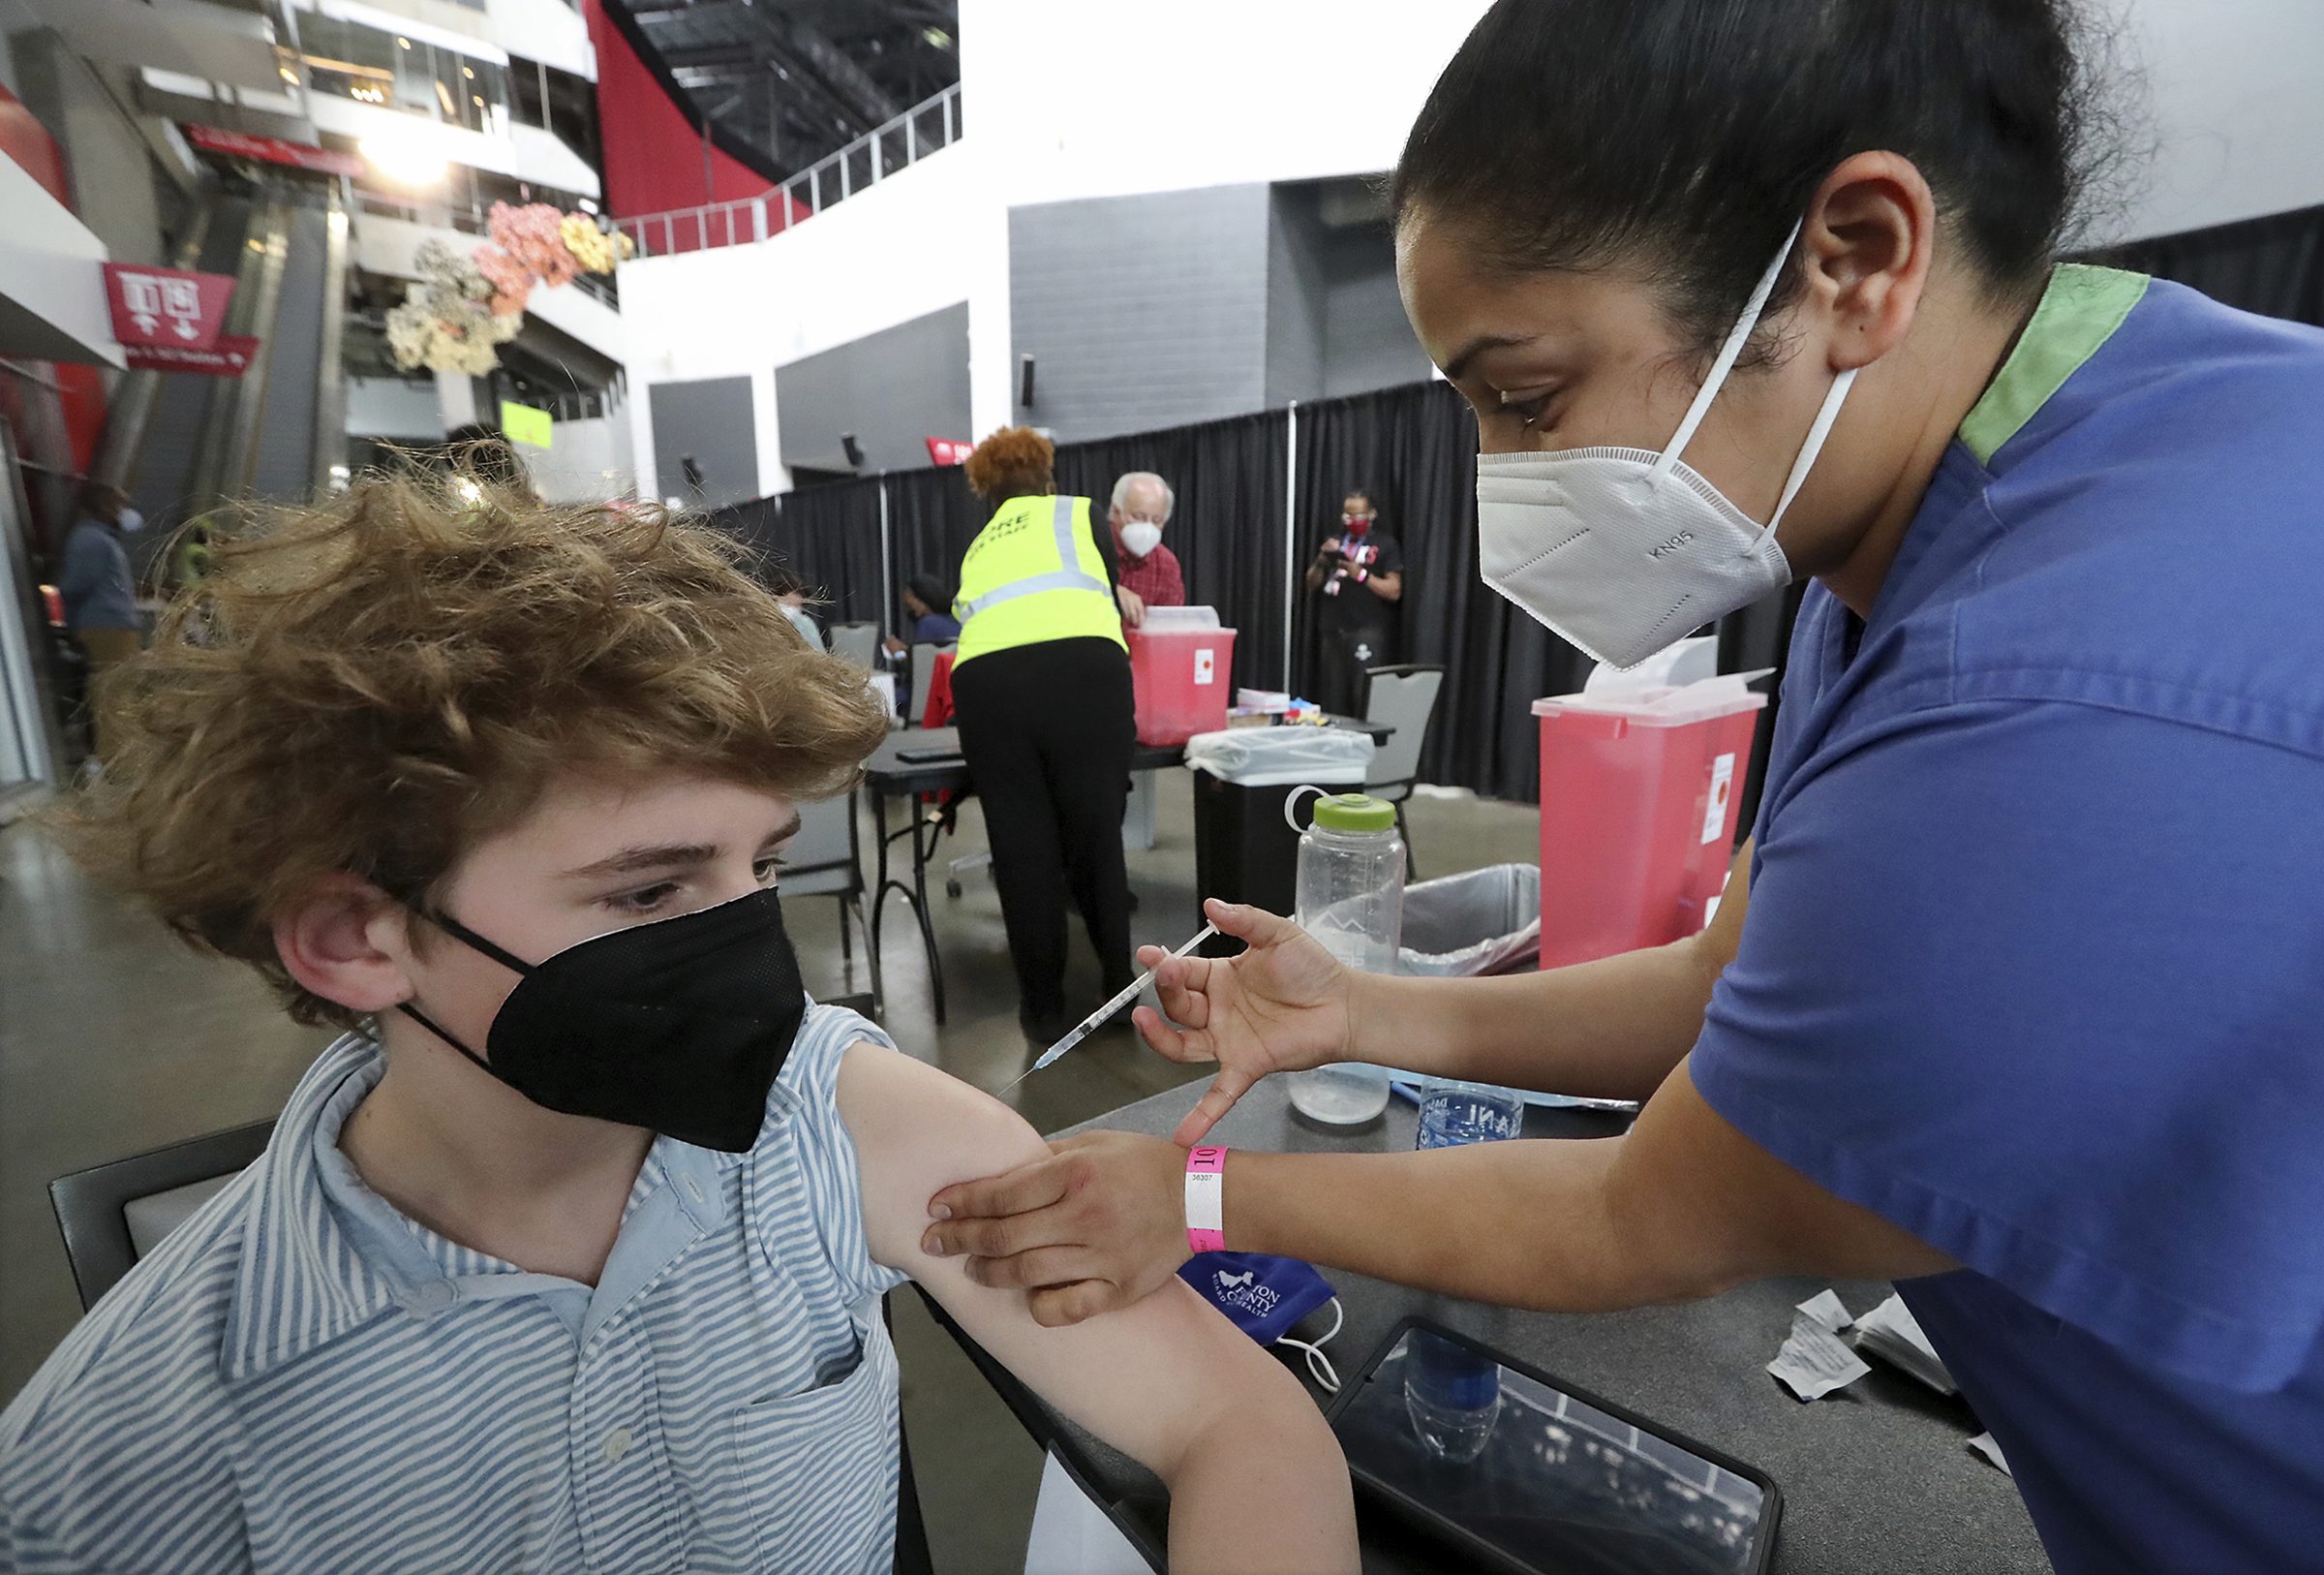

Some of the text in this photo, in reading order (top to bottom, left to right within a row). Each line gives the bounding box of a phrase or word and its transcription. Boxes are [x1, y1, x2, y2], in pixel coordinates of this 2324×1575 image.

[1648, 530, 1694, 560] KN95
[1194, 1149, 1217, 1166] 10
[1212, 1273, 1227, 1302] BOARD
